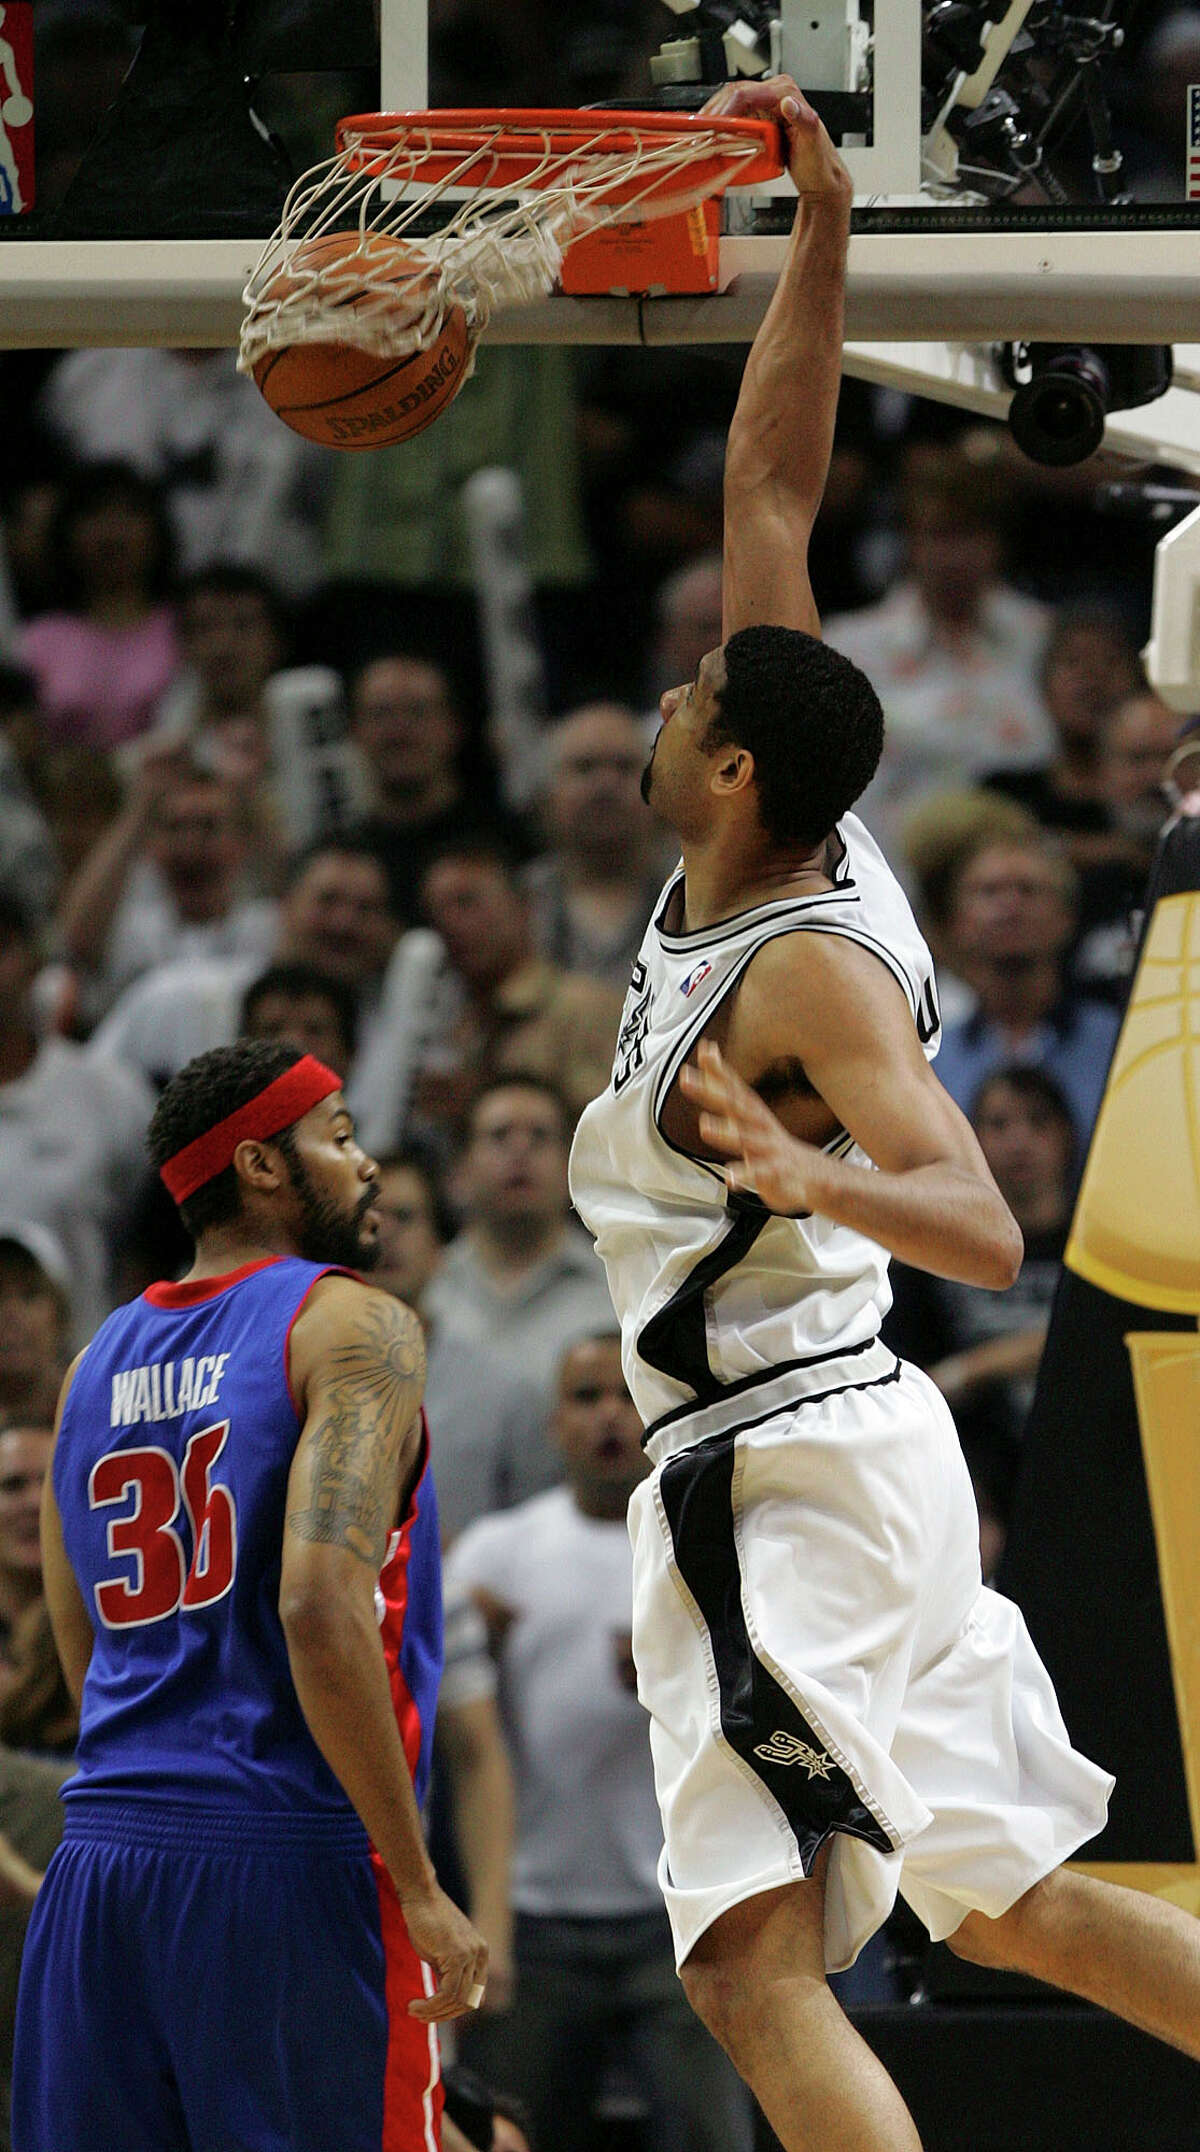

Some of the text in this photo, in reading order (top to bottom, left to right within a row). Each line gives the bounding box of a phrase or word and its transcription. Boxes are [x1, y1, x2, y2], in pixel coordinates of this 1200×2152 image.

[326, 346, 459, 439] SPALDING
[110, 1352, 231, 1428] WALLACE
[88, 1419, 238, 1630] 36
